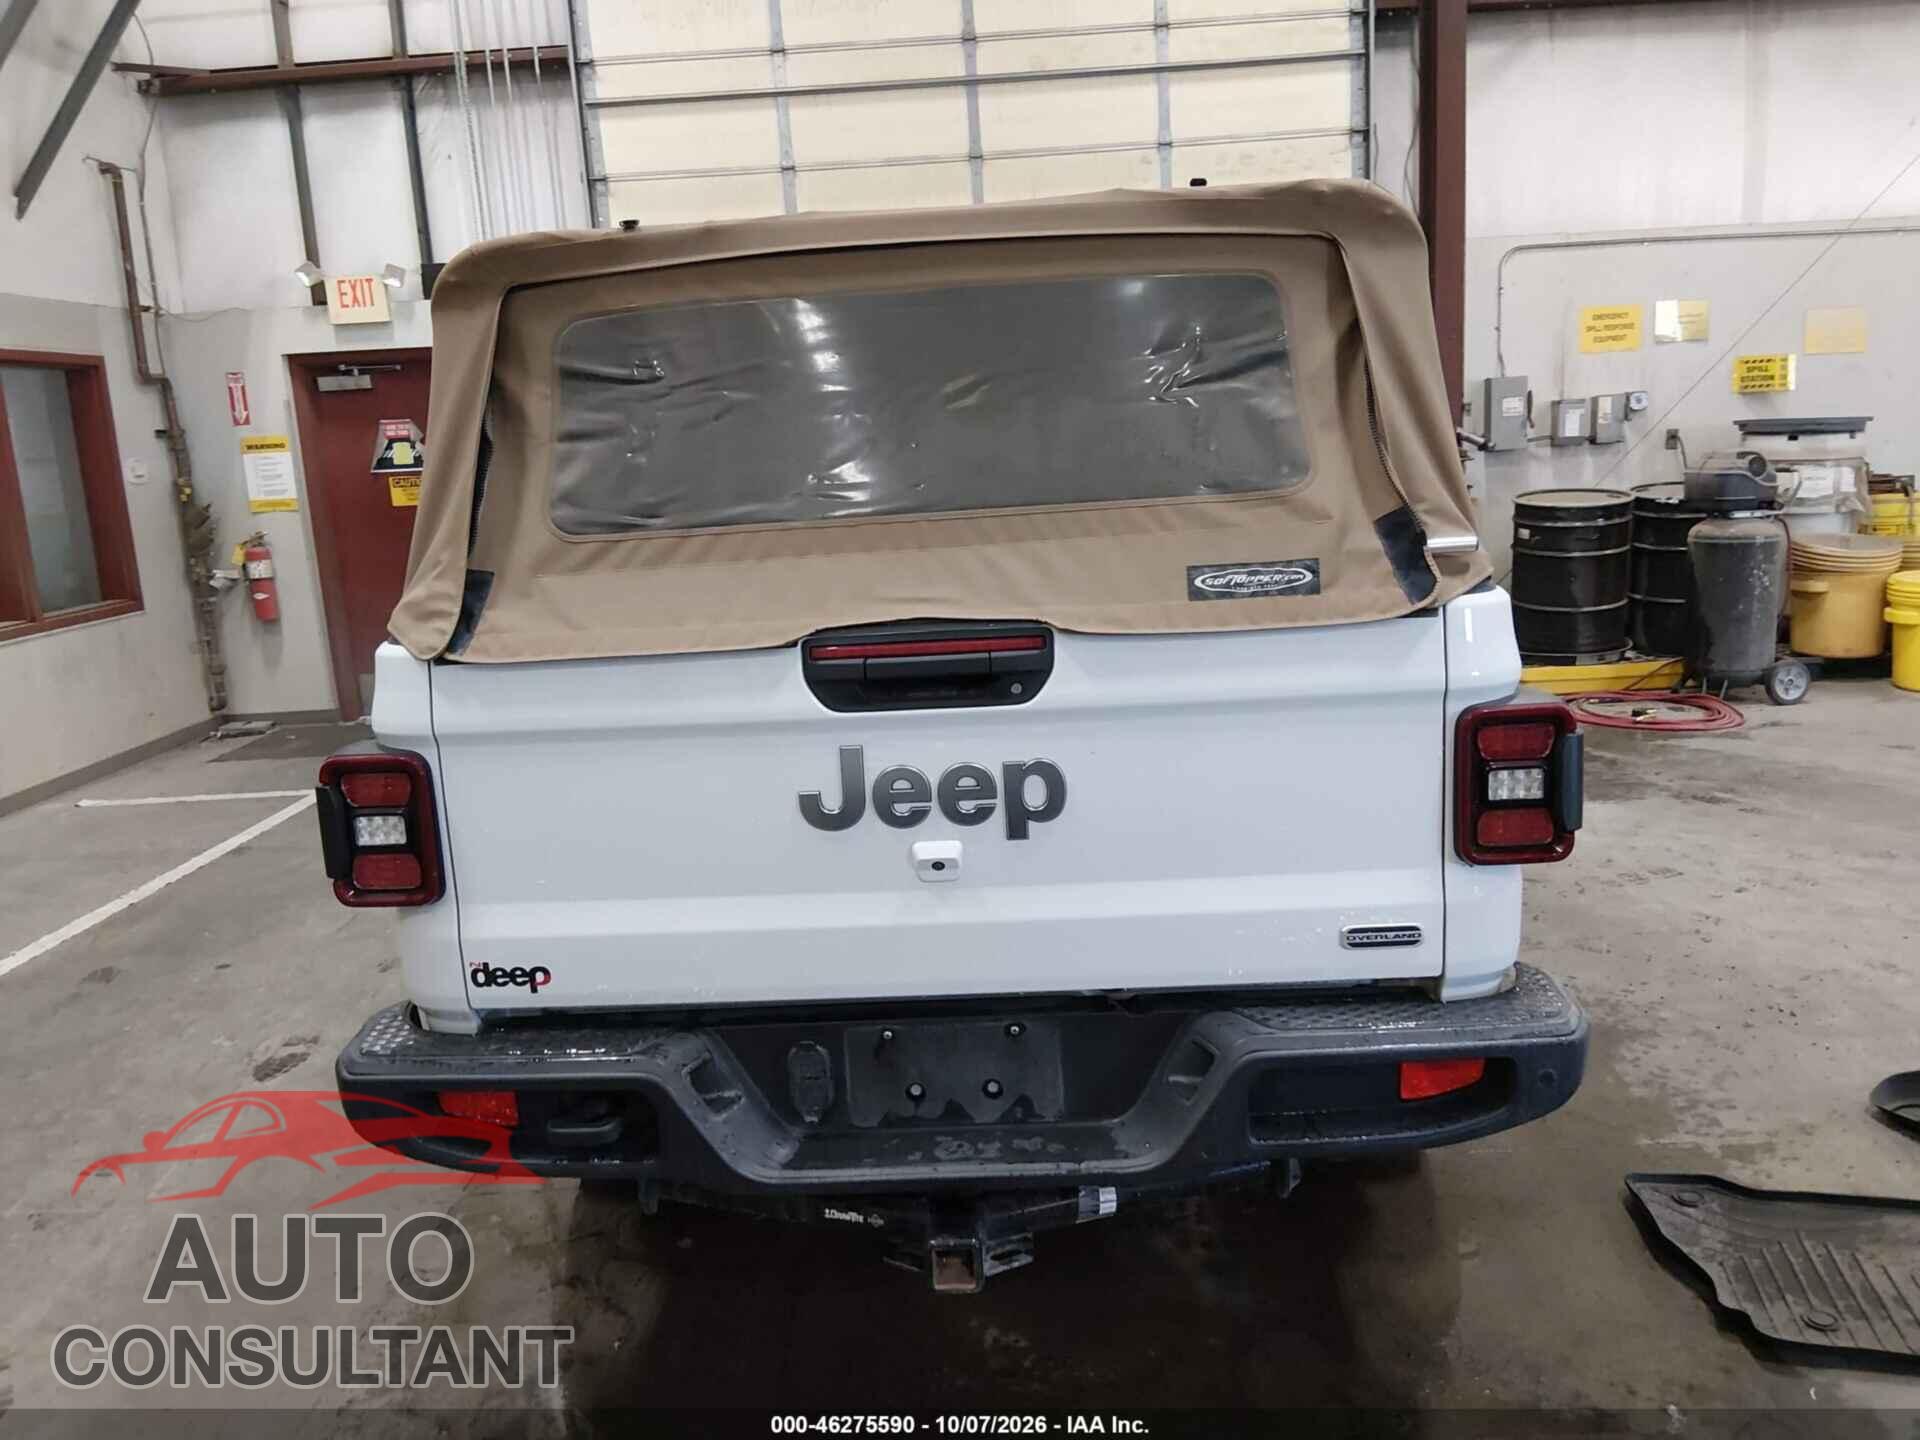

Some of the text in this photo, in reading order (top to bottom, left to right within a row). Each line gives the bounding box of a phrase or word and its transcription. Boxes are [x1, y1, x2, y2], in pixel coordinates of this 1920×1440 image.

[336, 278, 375, 308] EXIT
[1746, 364, 1769, 374] SPILL
[1740, 374, 1776, 383] STATION
[245, 442, 286, 450] WARNING
[798, 744, 1067, 840] Jeep
[1346, 932, 1422, 942] OVERLAND
[471, 962, 552, 994] deep
